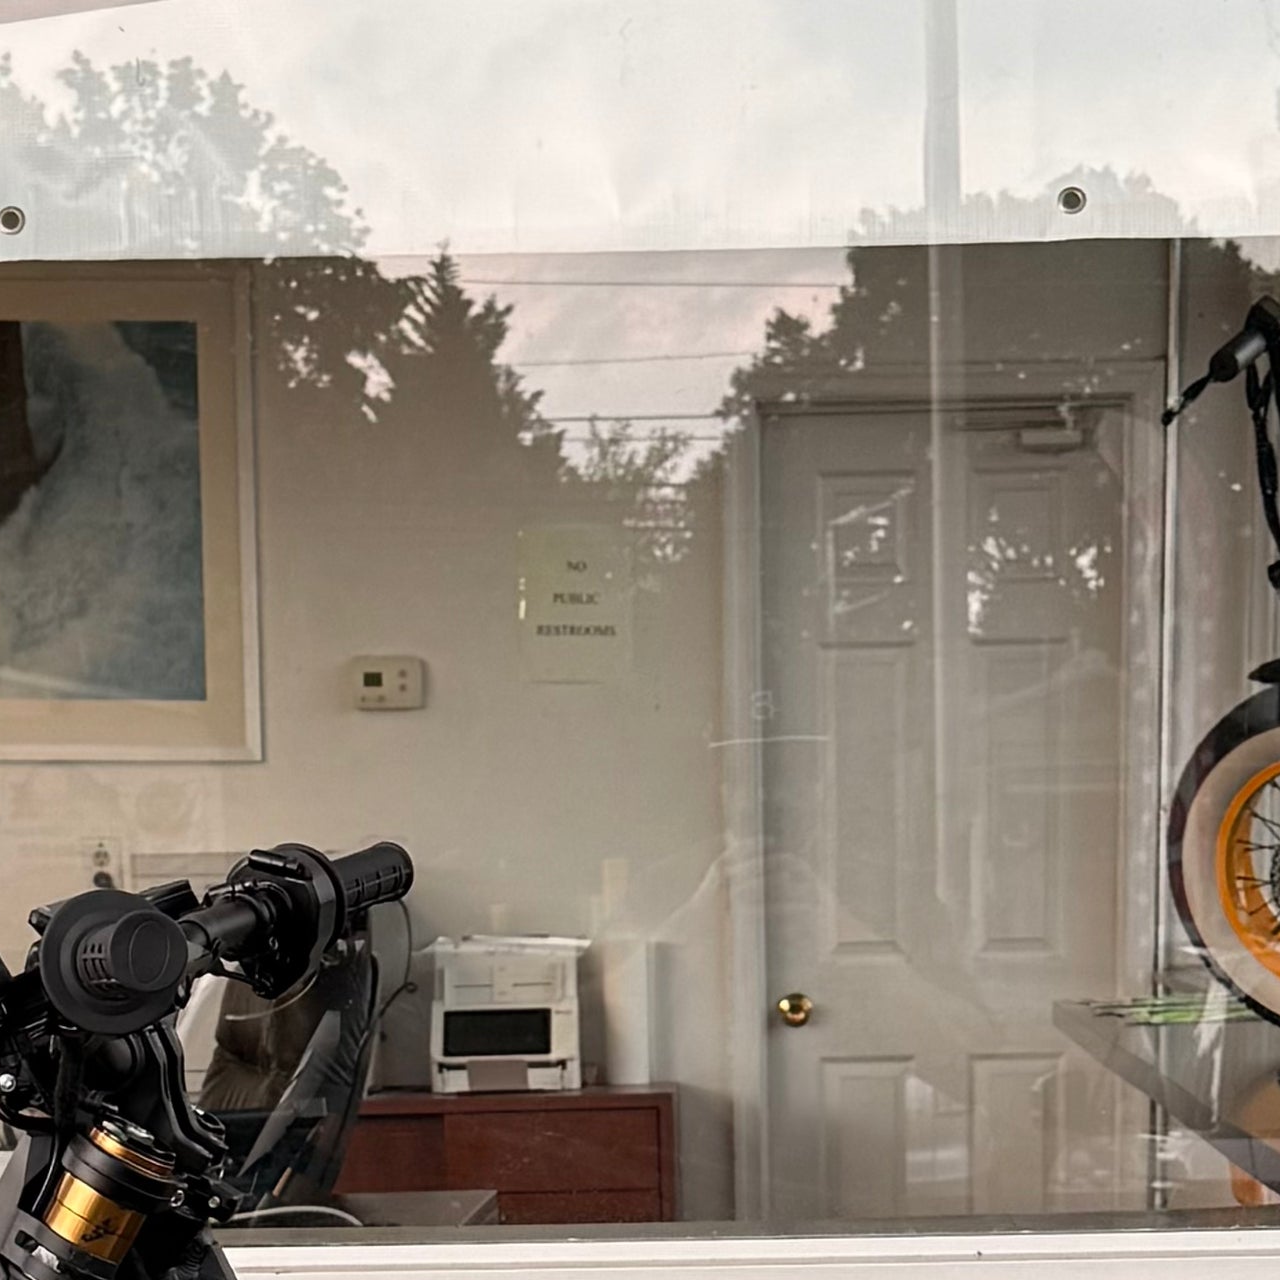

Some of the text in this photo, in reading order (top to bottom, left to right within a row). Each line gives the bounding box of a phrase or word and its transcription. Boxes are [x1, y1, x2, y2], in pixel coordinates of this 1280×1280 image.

[566, 560, 587, 573] NO
[552, 592, 599, 605] PUBLIC
[536, 624, 617, 637] RESTROOMS
